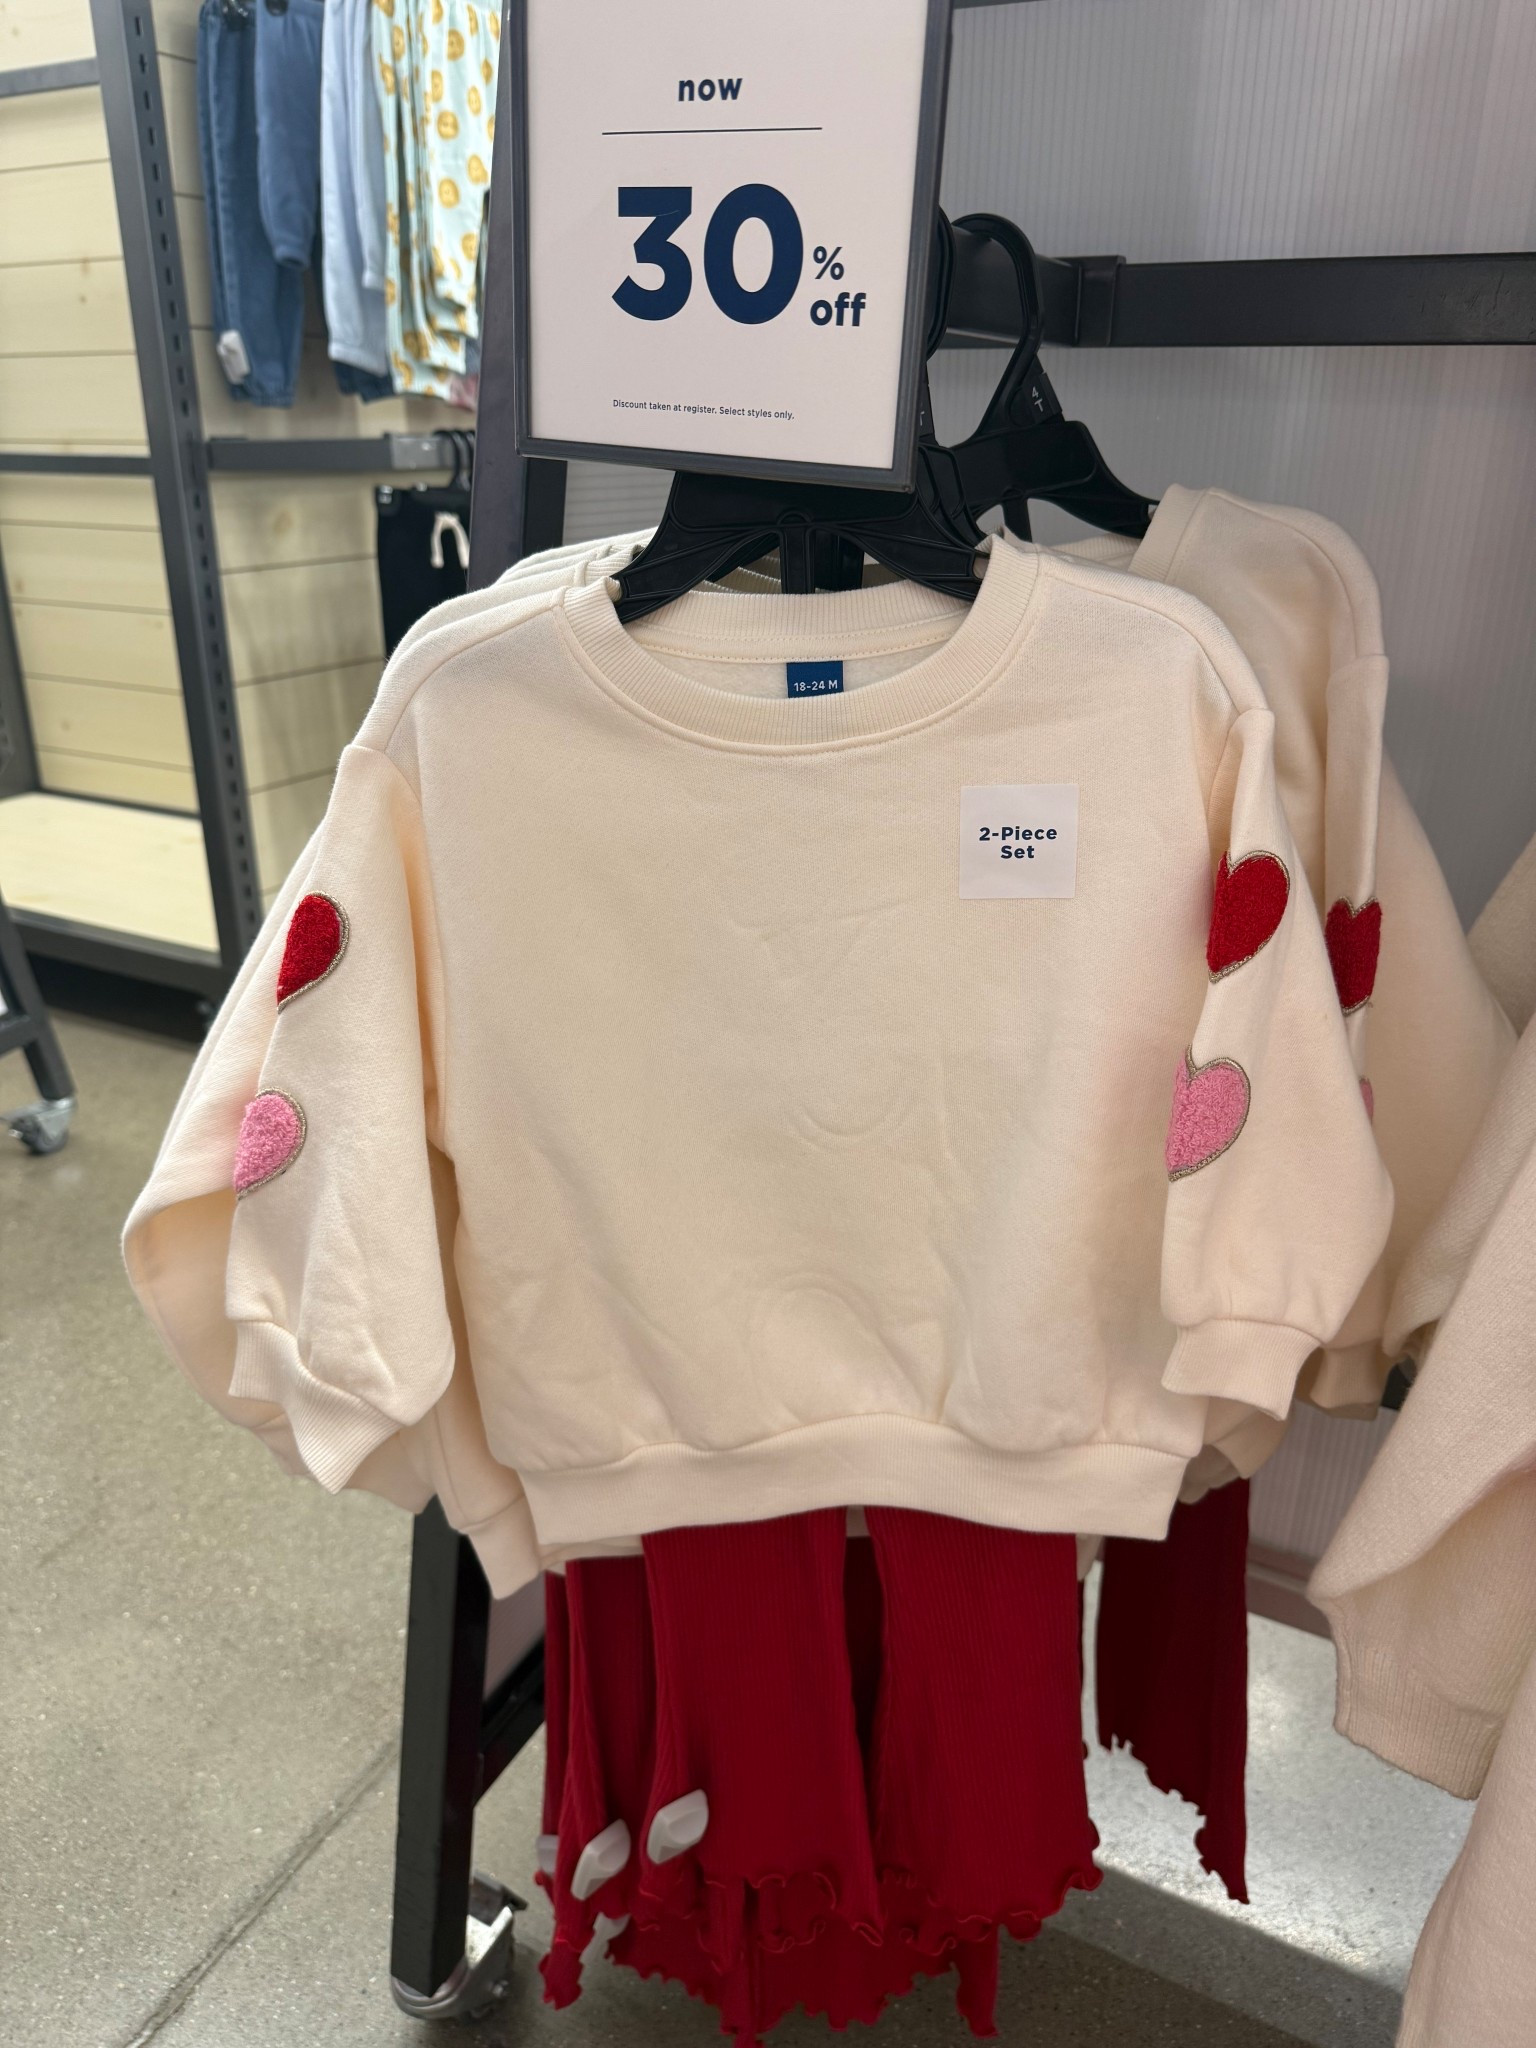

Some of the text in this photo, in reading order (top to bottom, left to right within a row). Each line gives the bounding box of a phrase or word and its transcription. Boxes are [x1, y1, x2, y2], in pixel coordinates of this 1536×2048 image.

[677, 77, 743, 102] now
[611, 183, 804, 325] 30
[810, 292, 867, 327] off
[612, 399, 795, 420] Discount taken at register. Select styles only.
[793, 679, 838, 692] 18-24 M
[979, 826, 1058, 841] 2-Piece
[1000, 845, 1035, 859] Set
